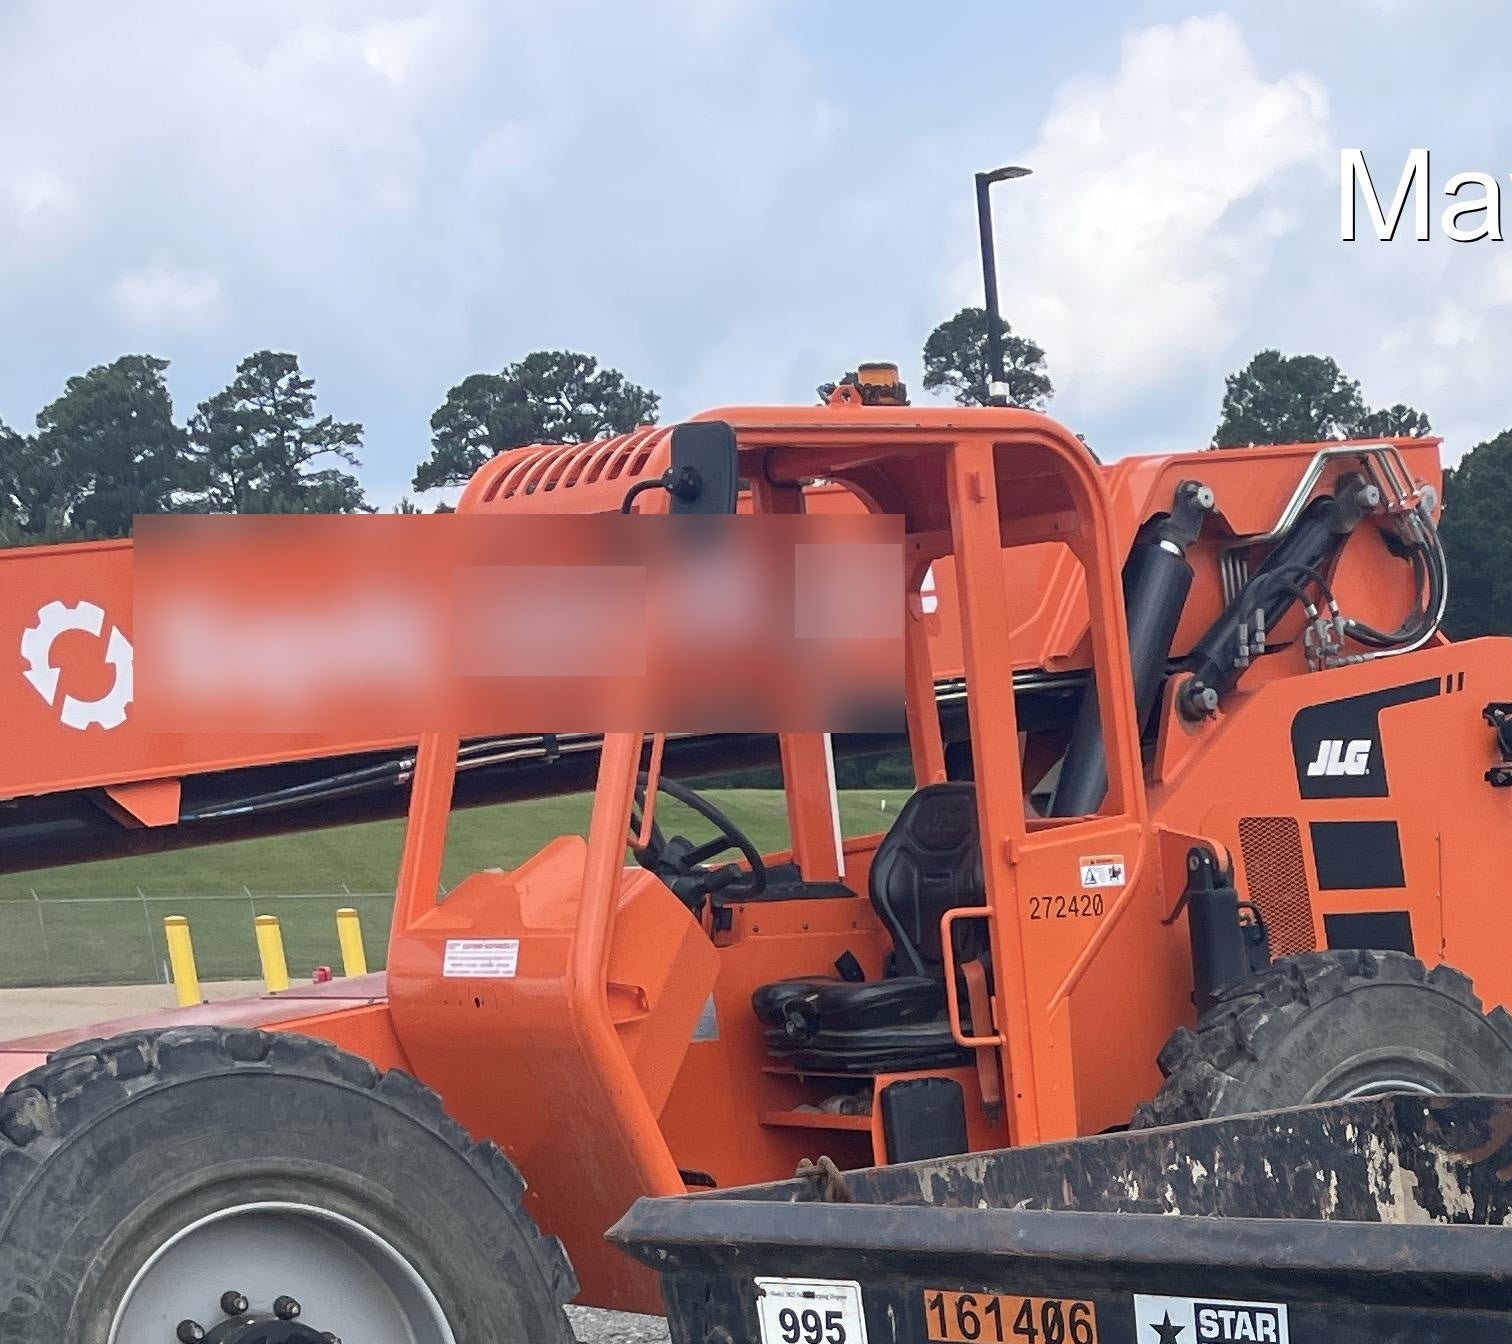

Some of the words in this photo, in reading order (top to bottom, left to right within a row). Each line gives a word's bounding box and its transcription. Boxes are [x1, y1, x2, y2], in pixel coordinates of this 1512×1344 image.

[1307, 739, 1372, 776] JLG
[1029, 894, 1104, 920] 272420
[1199, 1308, 1277, 1342] STAR
